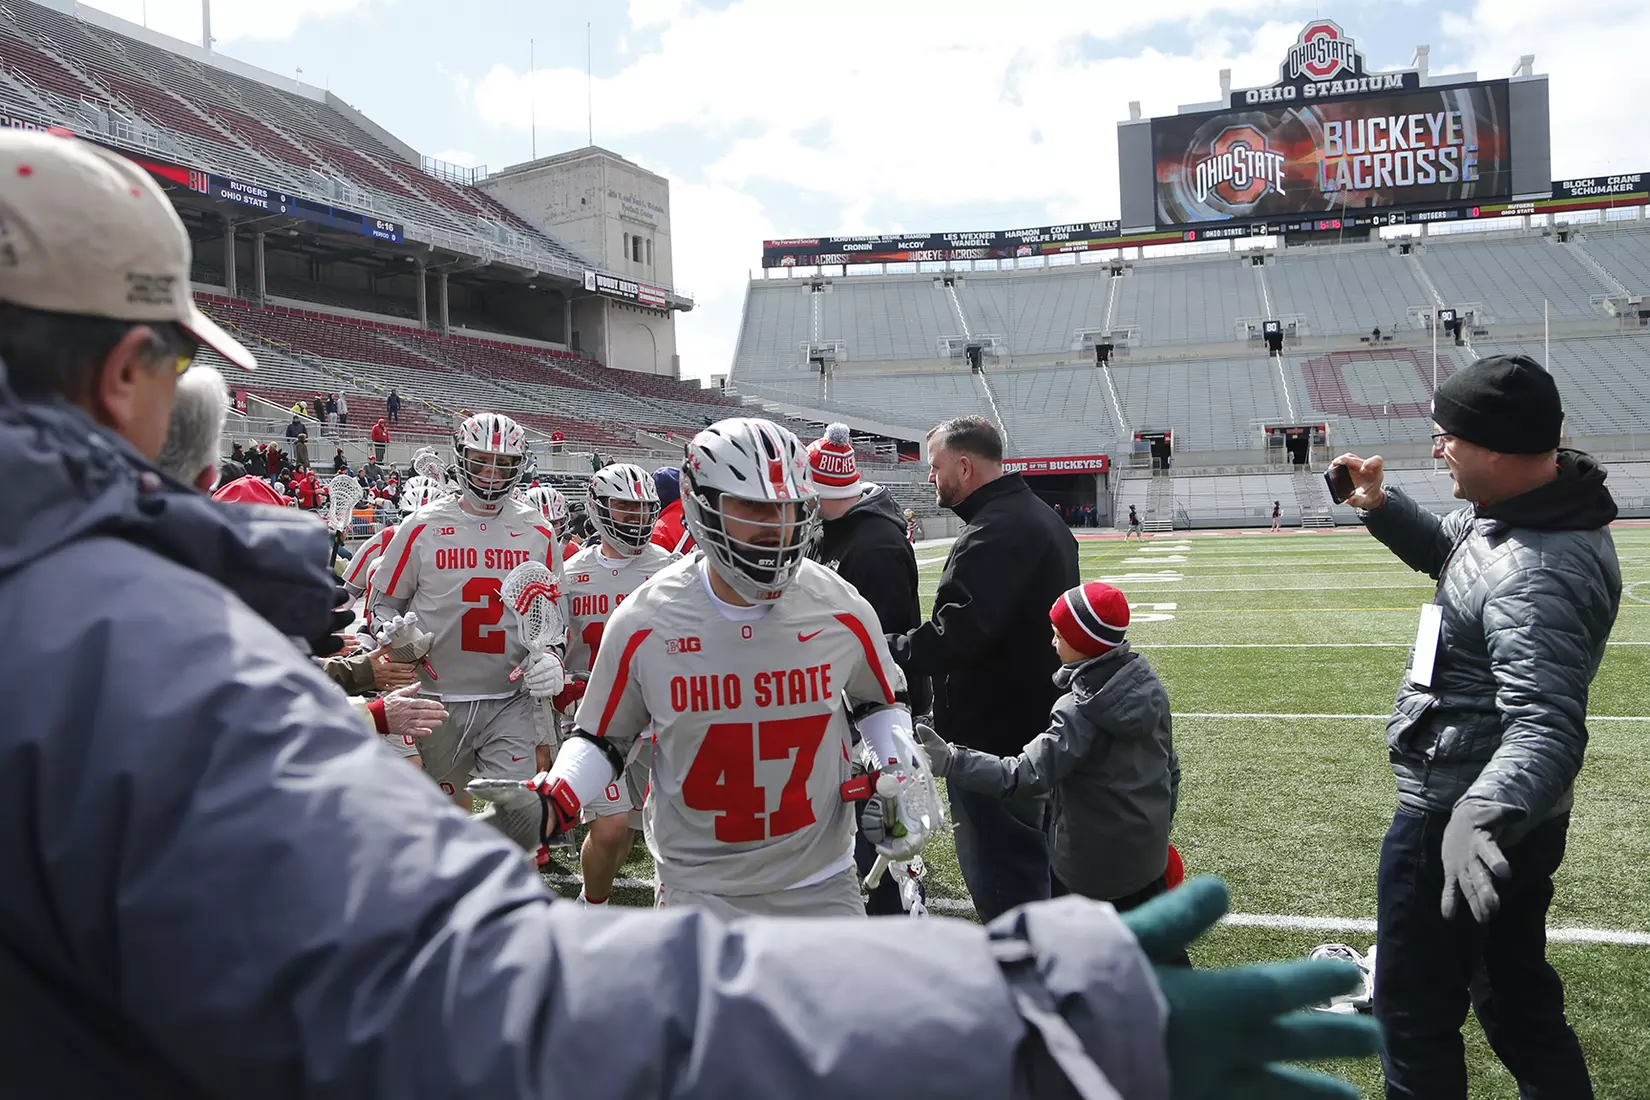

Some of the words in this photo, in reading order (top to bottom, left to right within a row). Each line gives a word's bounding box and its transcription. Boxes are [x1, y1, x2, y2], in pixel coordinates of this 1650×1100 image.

[1245, 85, 1297, 105] OHIO
[1303, 74, 1404, 99] STADIUM
[1323, 110, 1464, 158] BUCKEYE
[1319, 145, 1480, 193] LACROSSE
[1562, 179, 1595, 189] BLOCH
[1608, 174, 1641, 185] CRANE
[230, 180, 268, 198] RUTGERS
[280, 193, 286, 202] 0
[1571, 183, 1634, 196] SCHUMAKER
[220, 189, 242, 201] OHIO
[243, 193, 268, 209] STATE
[280, 205, 286, 214] 0
[376, 220, 394, 232] 6:16
[1050, 224, 1084, 234] COVELLI
[1089, 221, 1118, 230] WELLS
[1205, 230, 1221, 238] OHIO
[1223, 227, 1243, 236] STATE
[1418, 210, 1447, 220] RUTGERS
[372, 230, 390, 240] PERIOD
[943, 233, 958, 241] LES
[959, 232, 996, 240] WEXNER
[1004, 228, 1040, 239] HARMON
[1021, 234, 1050, 243] WOLFE
[1052, 233, 1069, 241] FDN
[842, 243, 873, 251] CRONIN
[898, 241, 925, 249] McCOY
[951, 239, 990, 247] WANDELL
[1266, 323, 1277, 332] 80
[1049, 459, 1103, 470] BUCKEYES
[435, 547, 478, 570] OHIO
[758, 558, 776, 566] STX
[572, 593, 609, 617] OHIO
[461, 576, 506, 655] 2
[670, 673, 742, 713] OHIO
[753, 663, 832, 708] STATE
[681, 713, 832, 843] 47
